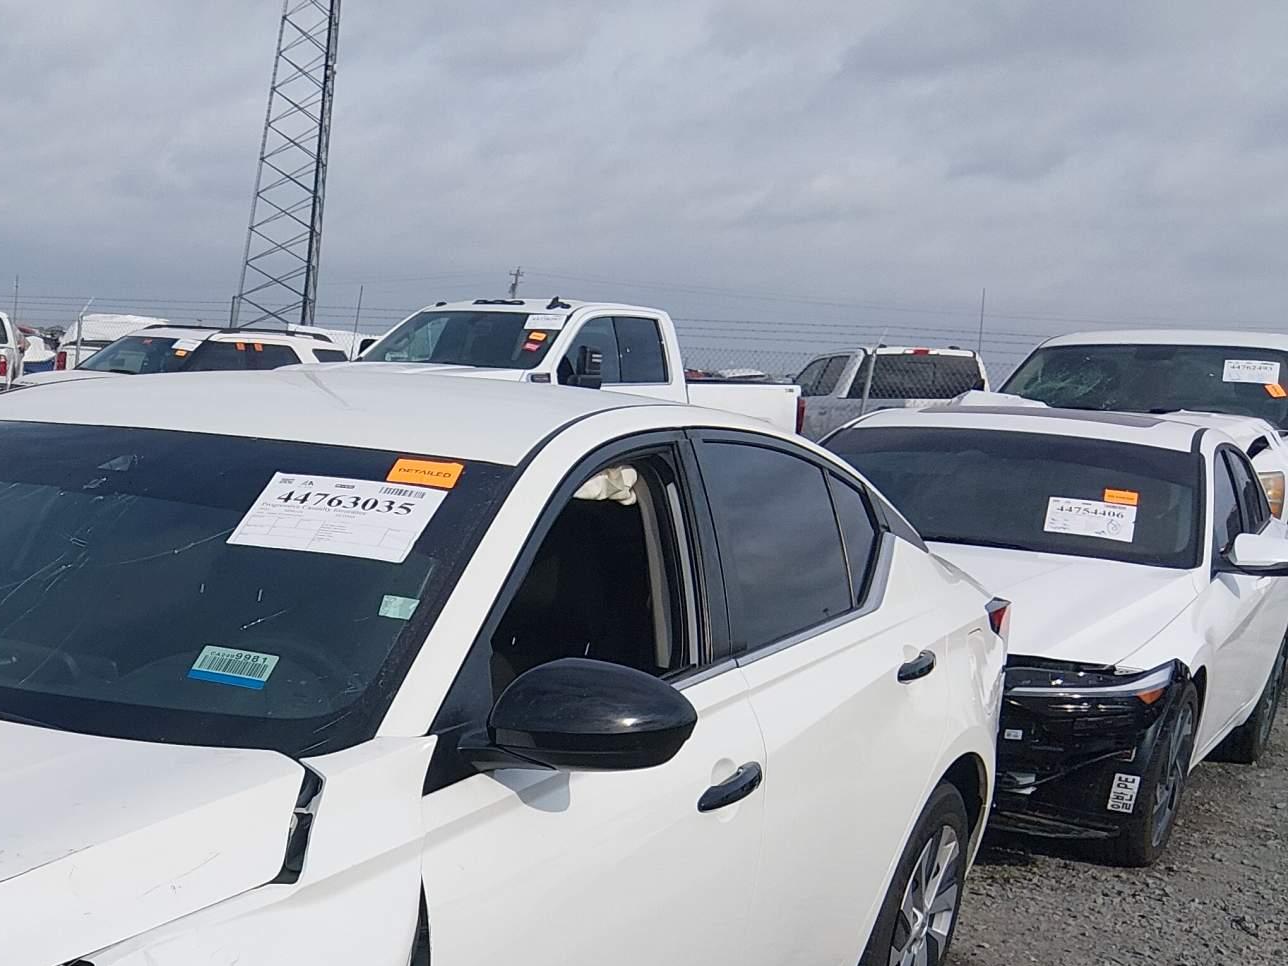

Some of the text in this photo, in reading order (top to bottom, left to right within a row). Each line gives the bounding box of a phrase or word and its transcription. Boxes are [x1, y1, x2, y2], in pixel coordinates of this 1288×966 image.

[398, 467, 452, 479] DETAILED
[277, 490, 416, 516] 44763035
[1117, 776, 1136, 790] PE
